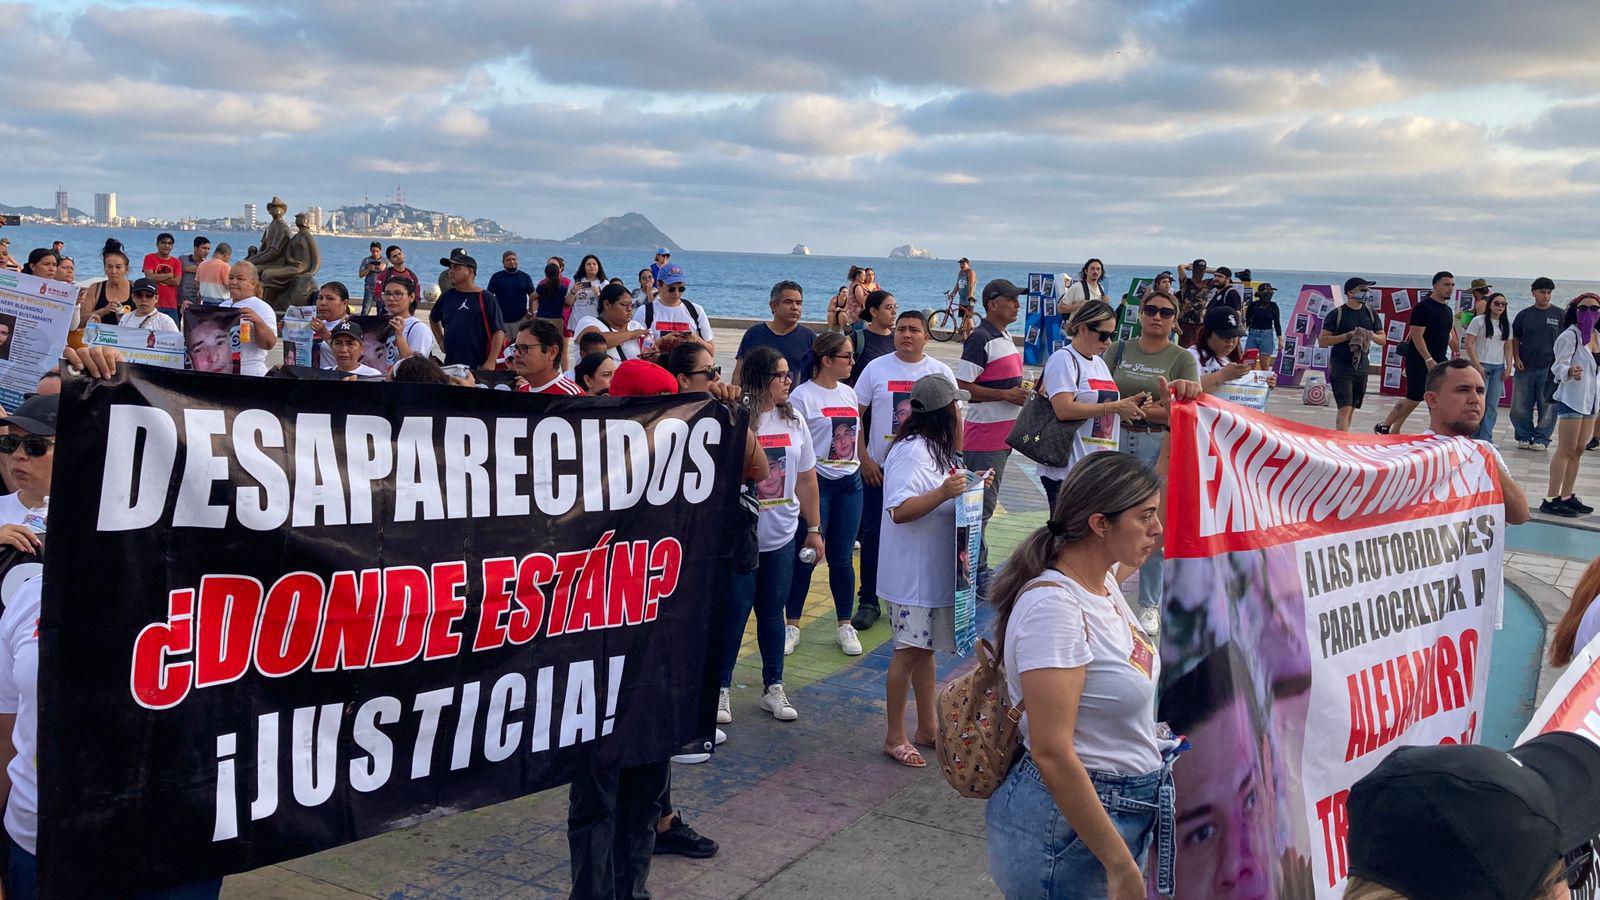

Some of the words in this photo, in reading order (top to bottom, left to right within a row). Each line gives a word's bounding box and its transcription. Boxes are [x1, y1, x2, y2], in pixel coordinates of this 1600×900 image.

[97, 404, 722, 532] DESAPARECIDOS
[130, 560, 467, 710] ¿DONDE
[473, 529, 682, 652] ESTÁN?
[1304, 551, 1319, 598] A
[1318, 543, 1354, 593] LAS
[1319, 602, 1367, 659] PARA
[212, 655, 626, 842] ¡JUSTICIA!
